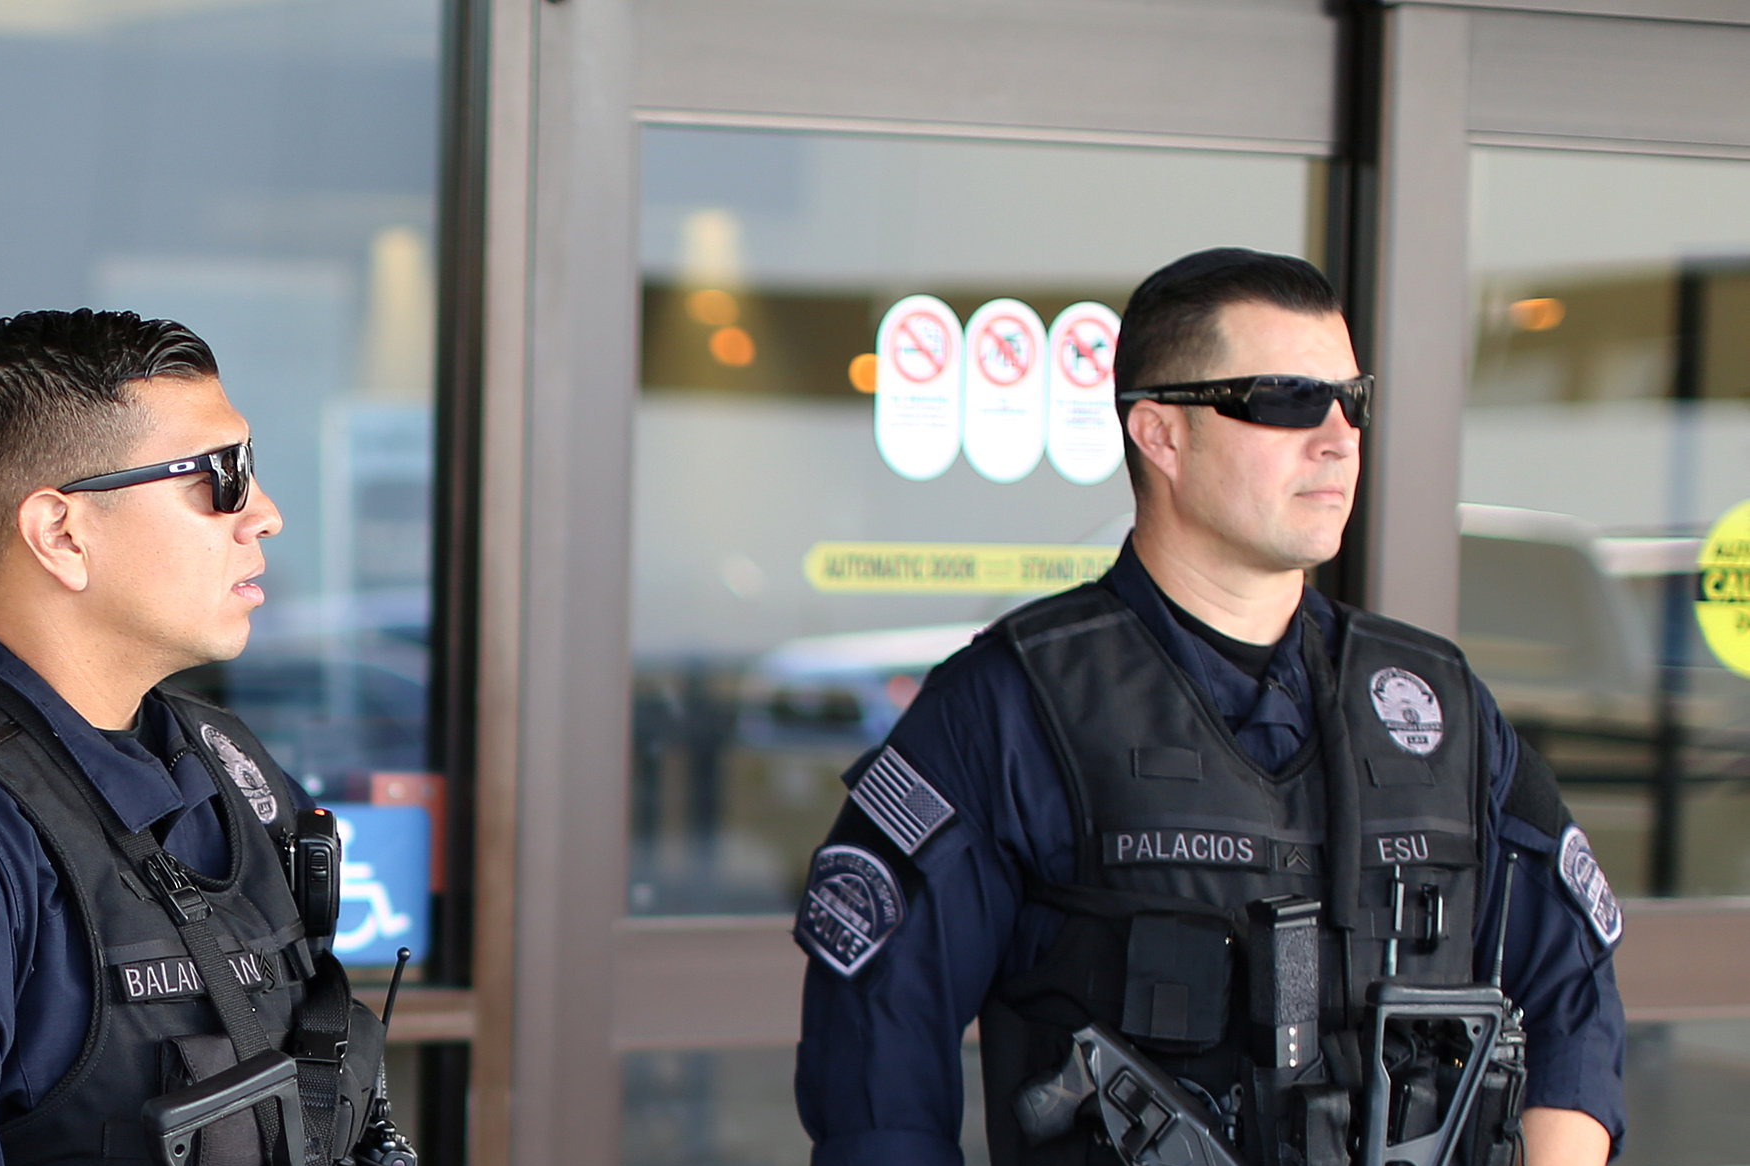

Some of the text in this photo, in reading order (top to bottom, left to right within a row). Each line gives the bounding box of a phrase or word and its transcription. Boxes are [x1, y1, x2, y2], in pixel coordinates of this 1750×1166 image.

[1117, 832, 1254, 863] PALACIOS
[1378, 834, 1429, 863] ESU
[807, 901, 864, 960] POLICE
